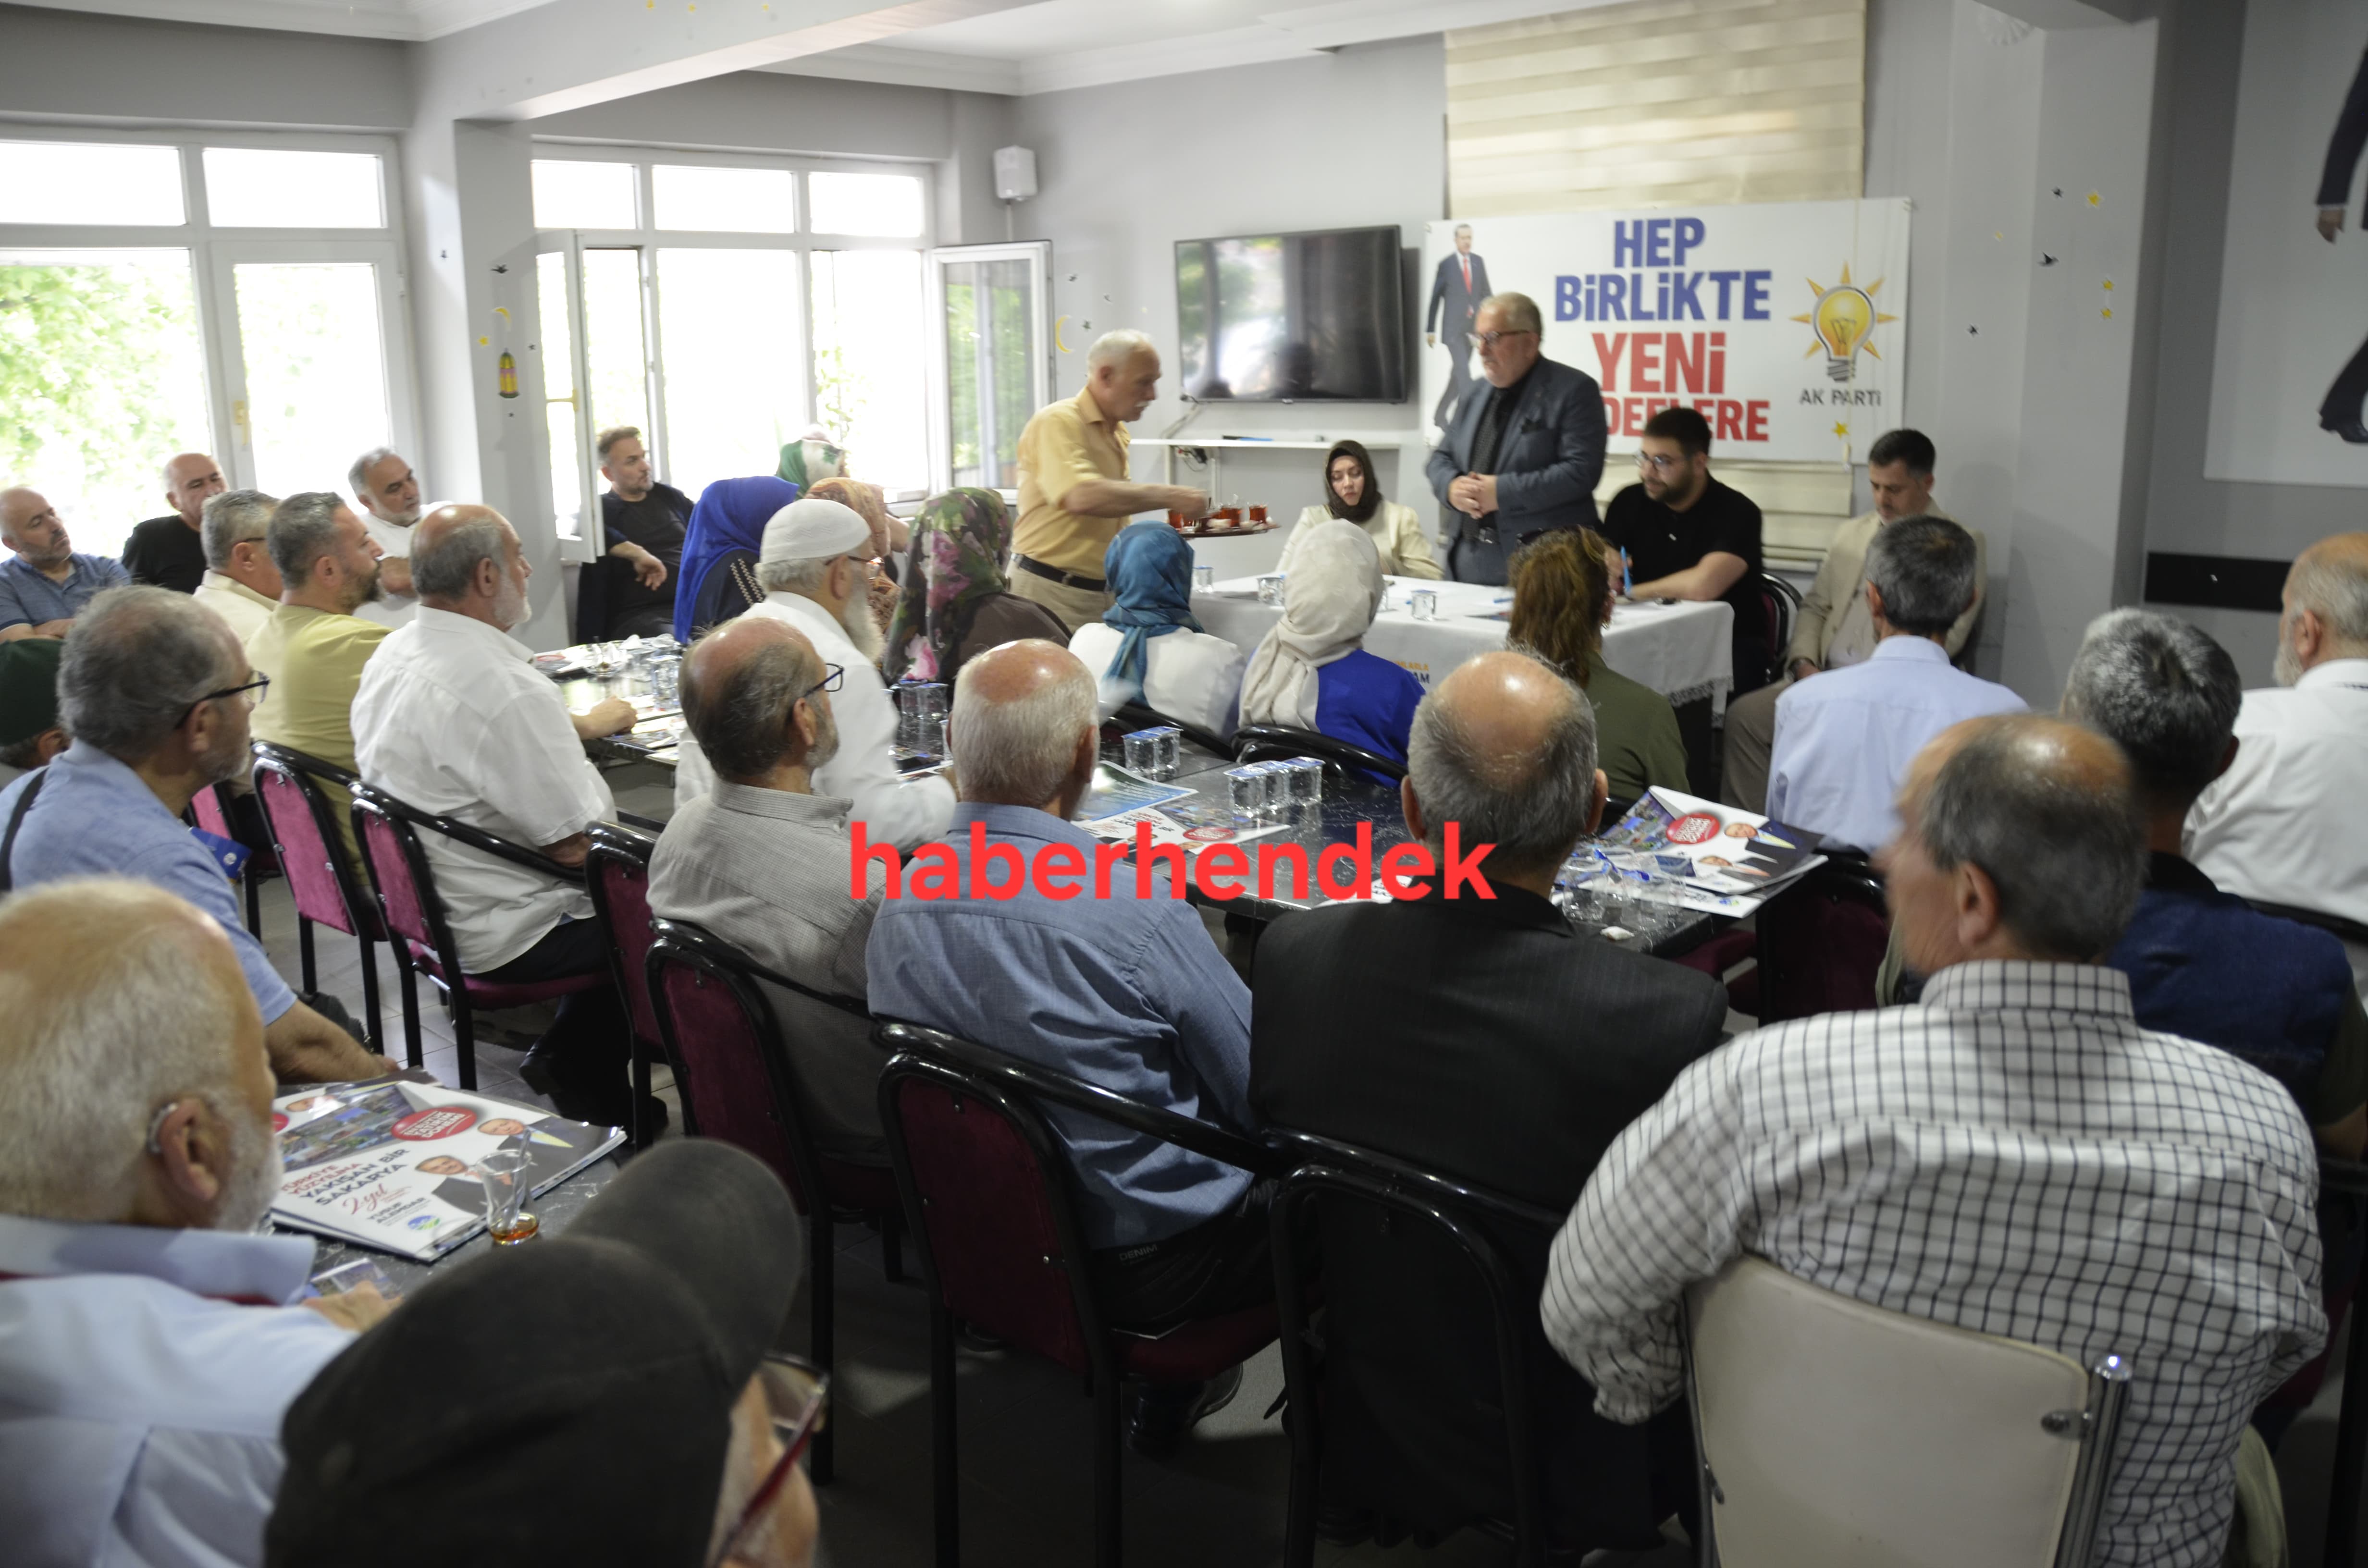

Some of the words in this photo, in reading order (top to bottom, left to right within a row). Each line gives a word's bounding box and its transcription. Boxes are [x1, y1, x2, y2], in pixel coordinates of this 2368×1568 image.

[1614, 218, 1705, 268] HEP
[1799, 388, 1825, 405] AK
[315, 1164, 408, 1206] SAKARYA
[1119, 1244, 1158, 1261] DENIM
